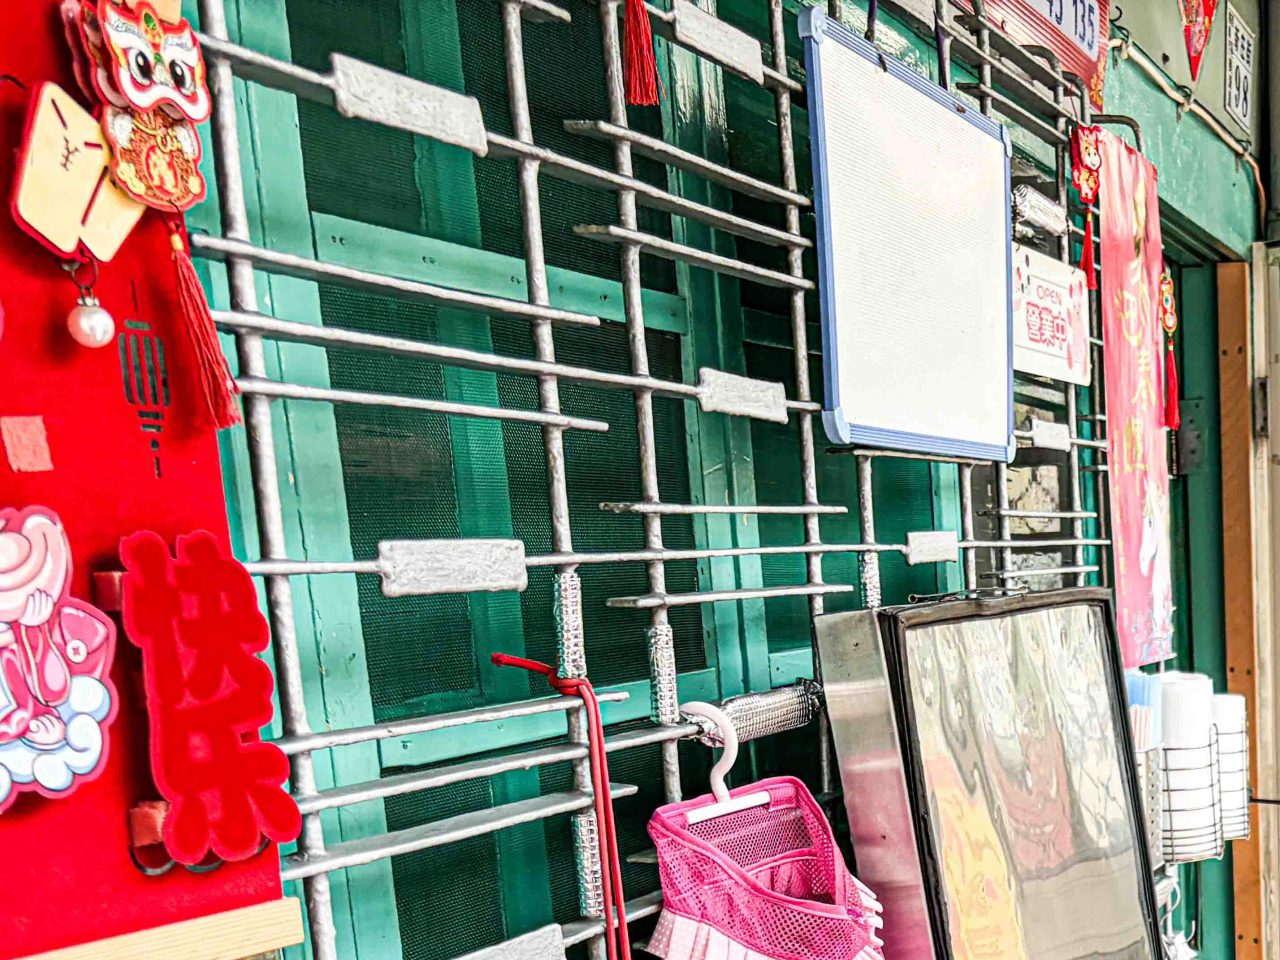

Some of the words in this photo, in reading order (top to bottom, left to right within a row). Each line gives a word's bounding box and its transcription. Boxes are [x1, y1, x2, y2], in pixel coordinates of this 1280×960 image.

[1234, 65, 1249, 118] 98
[1036, 285, 1063, 305] OPEN
[1026, 301, 1067, 350] 營業中
